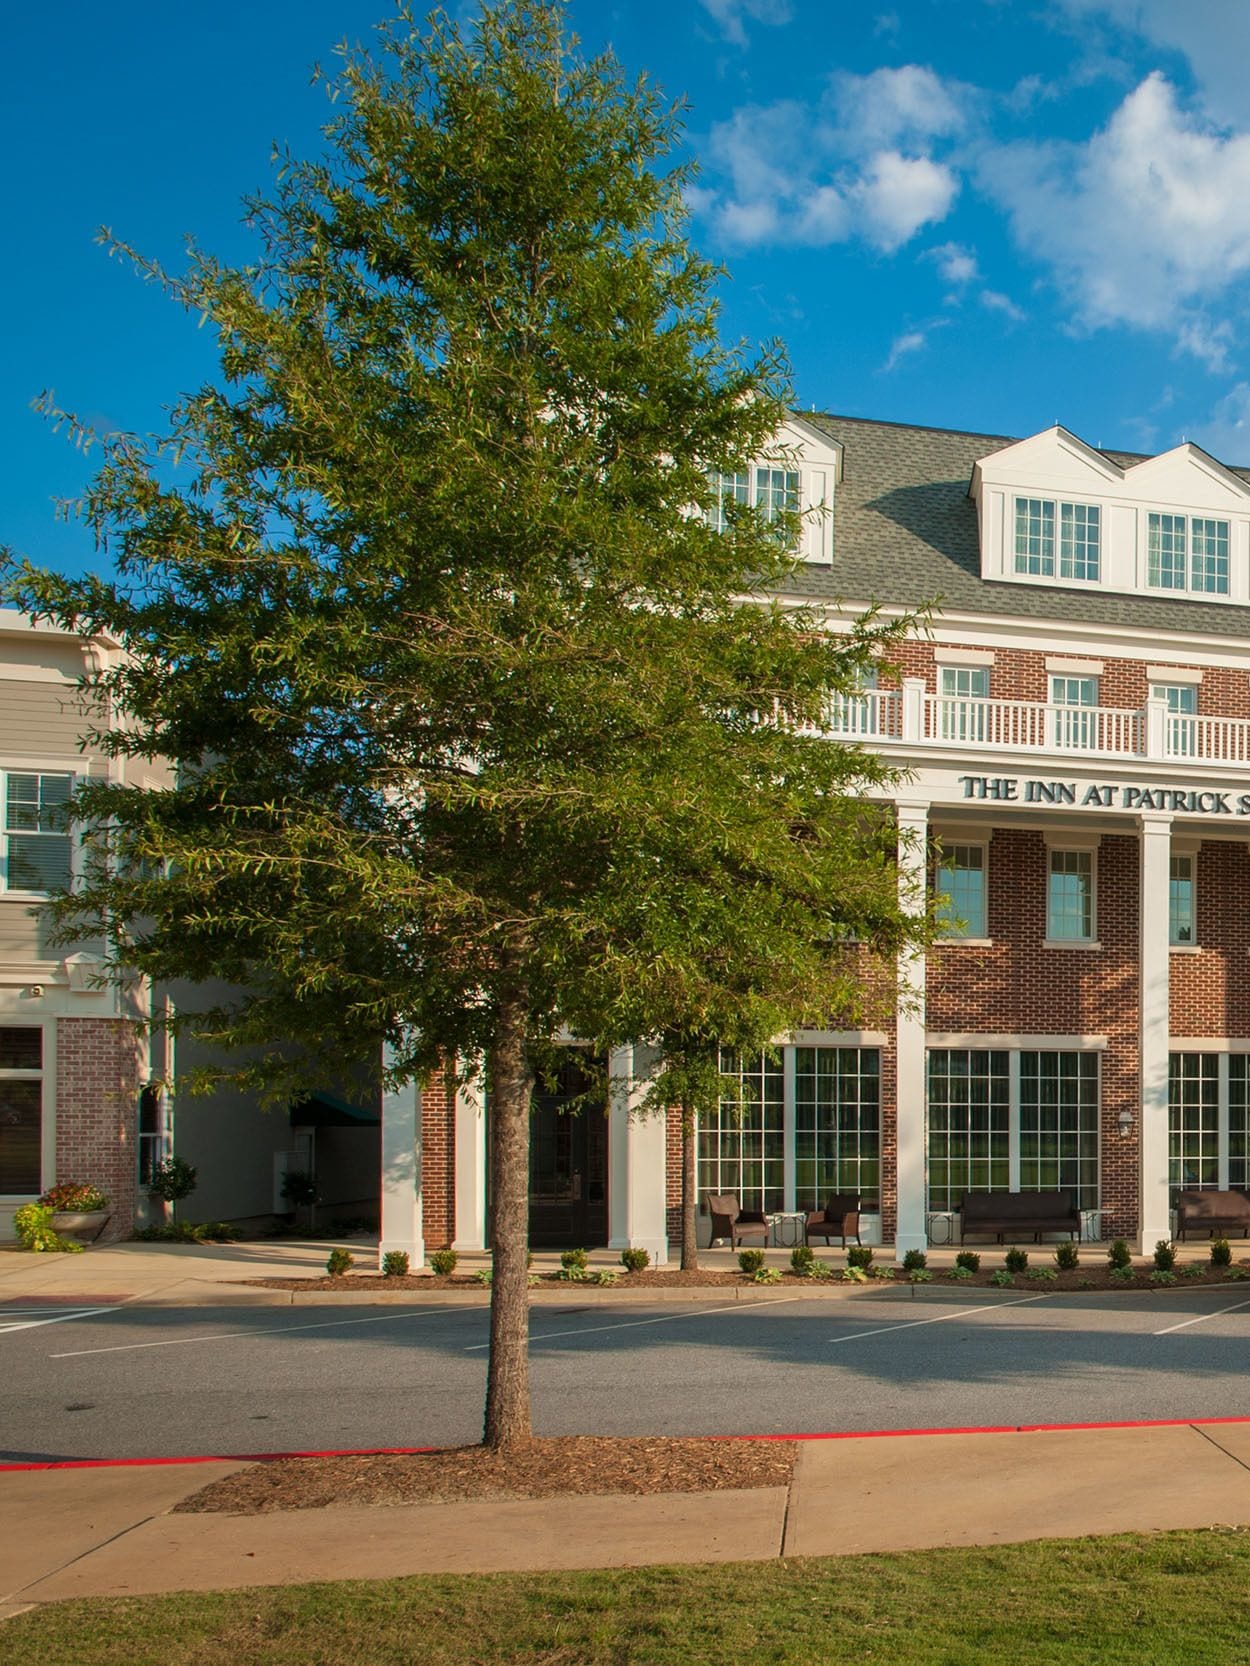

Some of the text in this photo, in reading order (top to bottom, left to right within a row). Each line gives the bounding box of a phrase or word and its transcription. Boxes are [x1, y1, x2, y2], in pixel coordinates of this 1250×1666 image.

[958, 776, 1018, 800] THE
[1024, 781, 1077, 804] INN
[1081, 785, 1118, 807] AT
[1122, 787, 1232, 814] PATRICK
